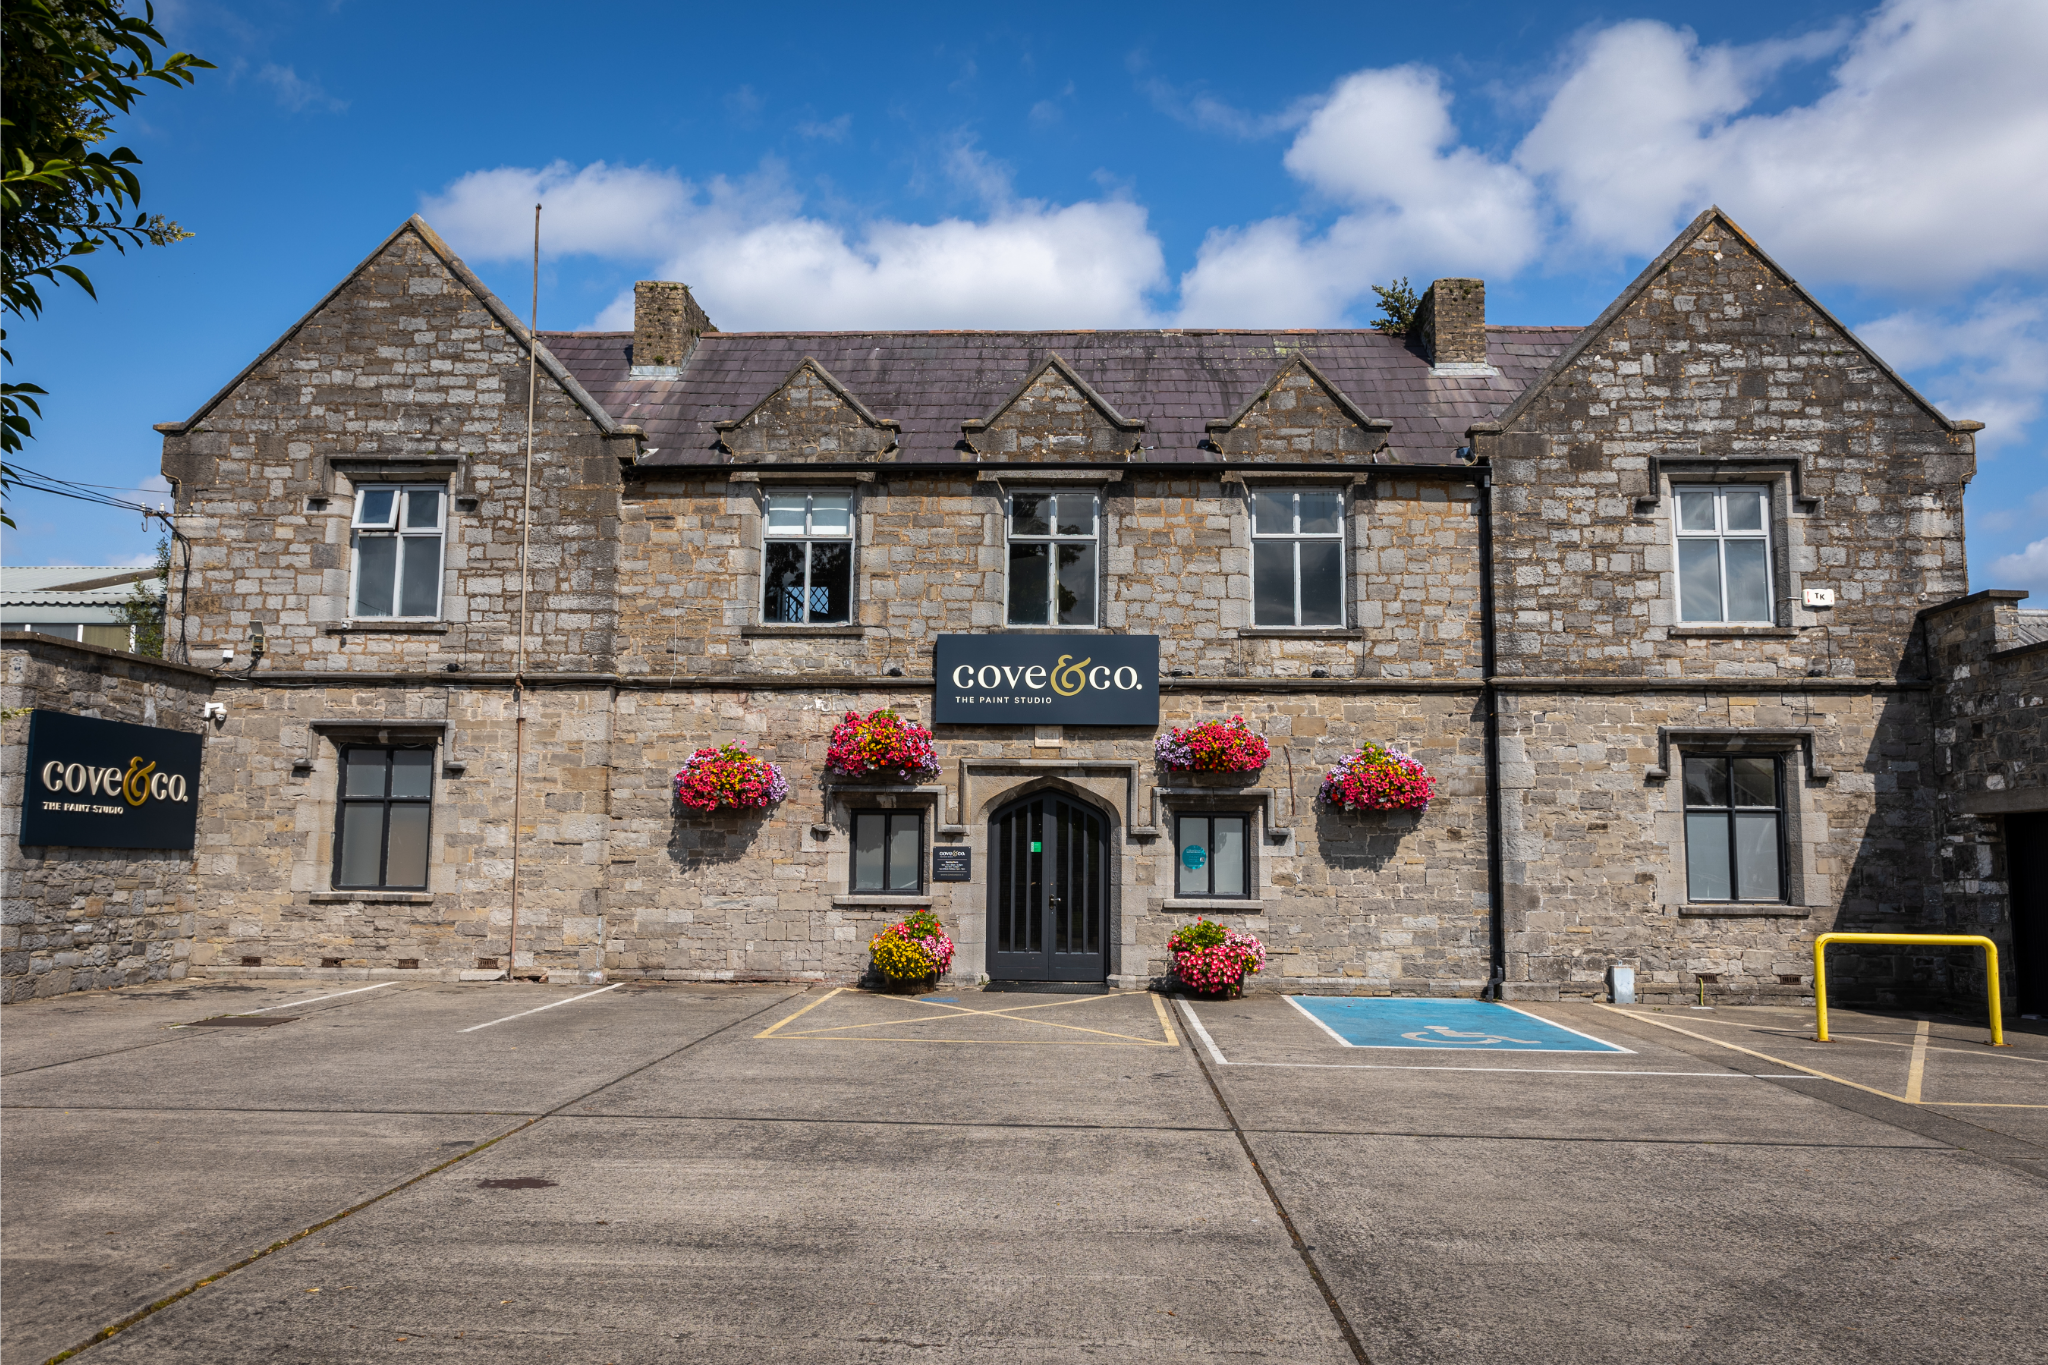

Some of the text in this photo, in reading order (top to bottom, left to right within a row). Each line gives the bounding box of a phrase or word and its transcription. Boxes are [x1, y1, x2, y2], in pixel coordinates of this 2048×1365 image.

[955, 696, 1052, 704] THE PAINT STUDIO
[43, 801, 124, 814] THE PAINT STUDIO
